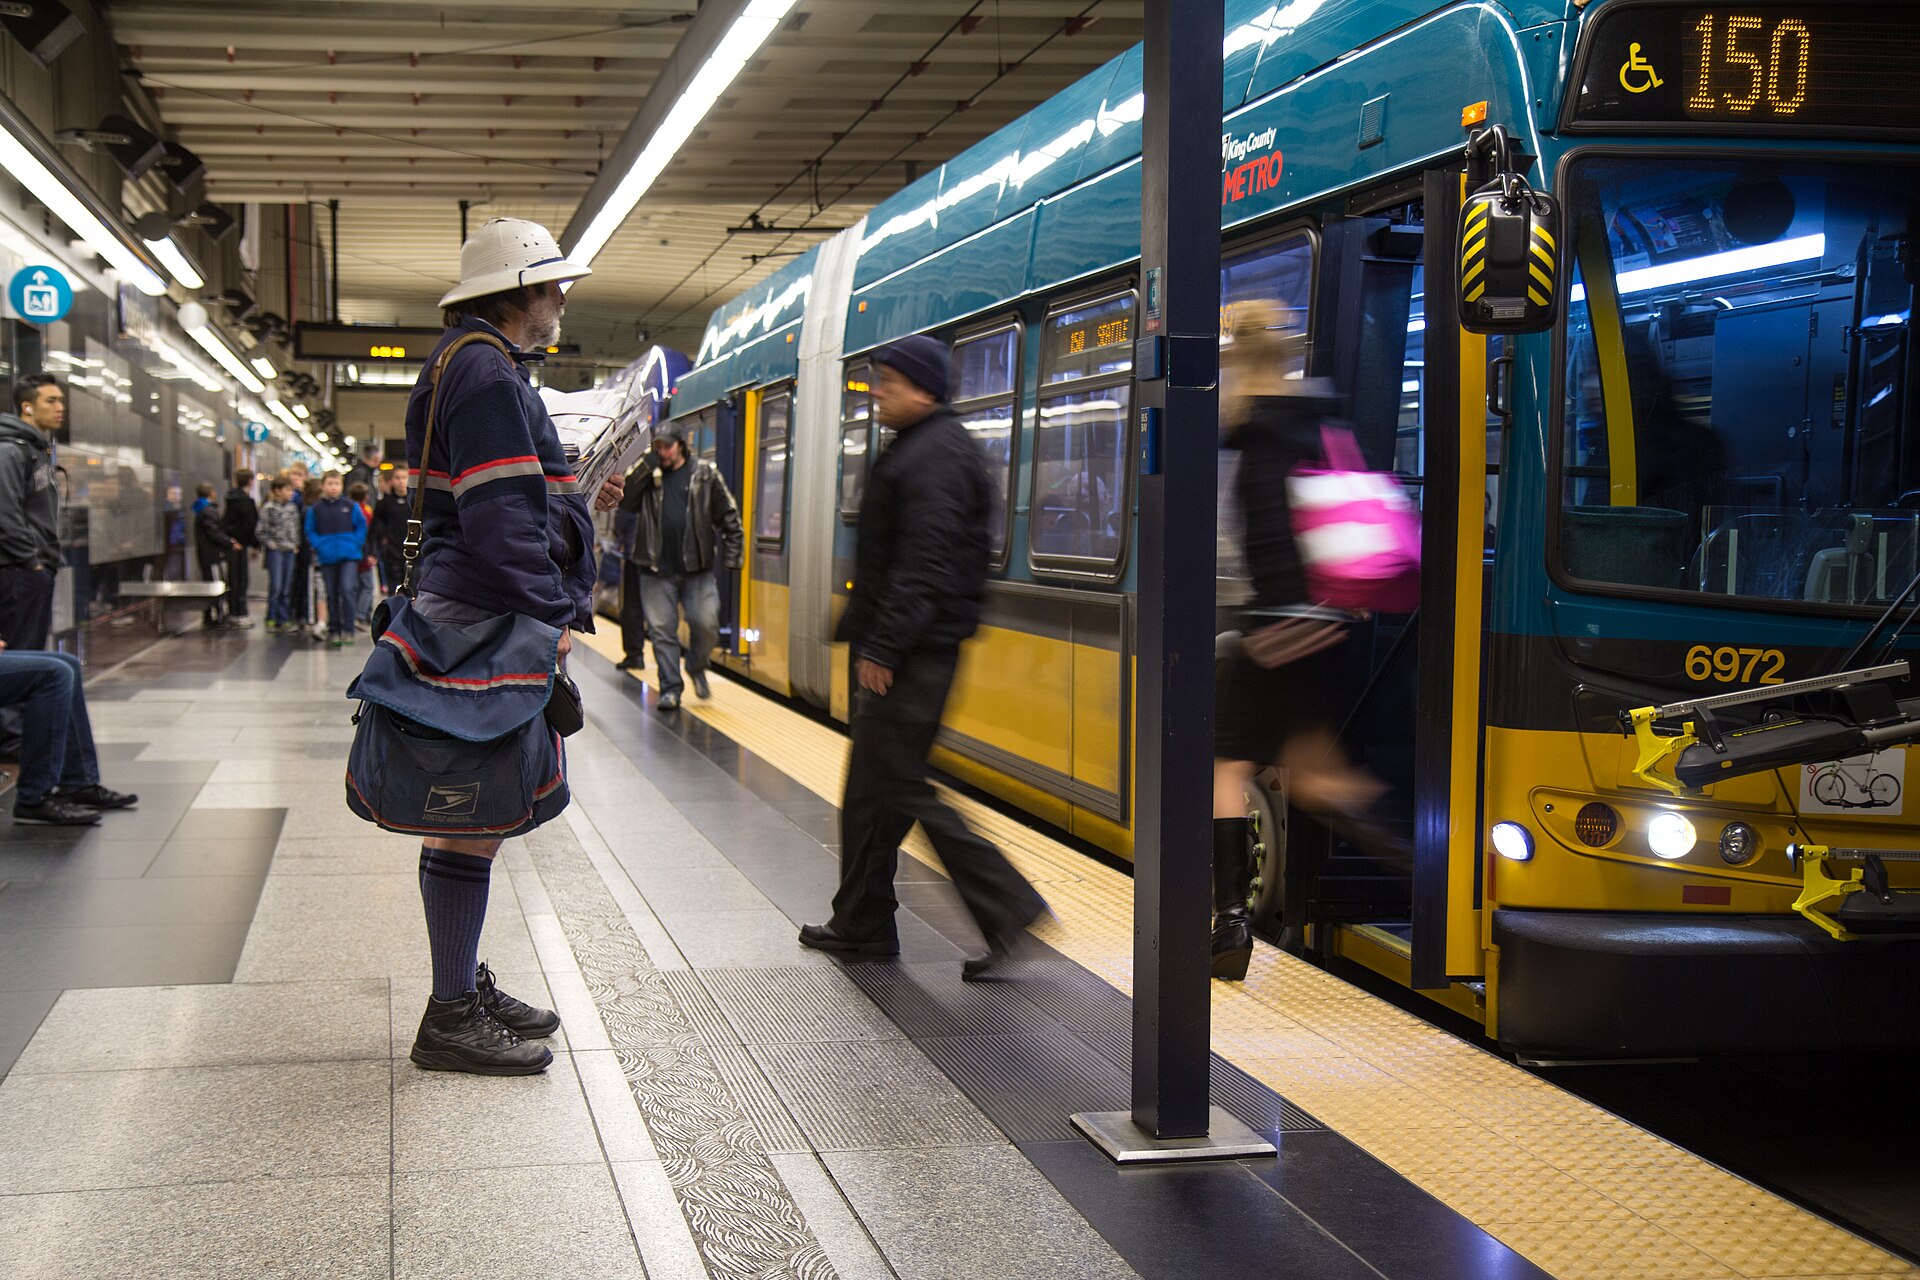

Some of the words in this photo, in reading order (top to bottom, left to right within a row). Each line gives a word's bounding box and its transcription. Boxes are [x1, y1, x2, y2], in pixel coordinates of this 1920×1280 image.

[1689, 13, 1810, 116] 150
[1227, 138, 1247, 162] King
[1247, 127, 1277, 153] County
[1222, 150, 1283, 206] METRO
[1684, 645, 1786, 684] 6972
